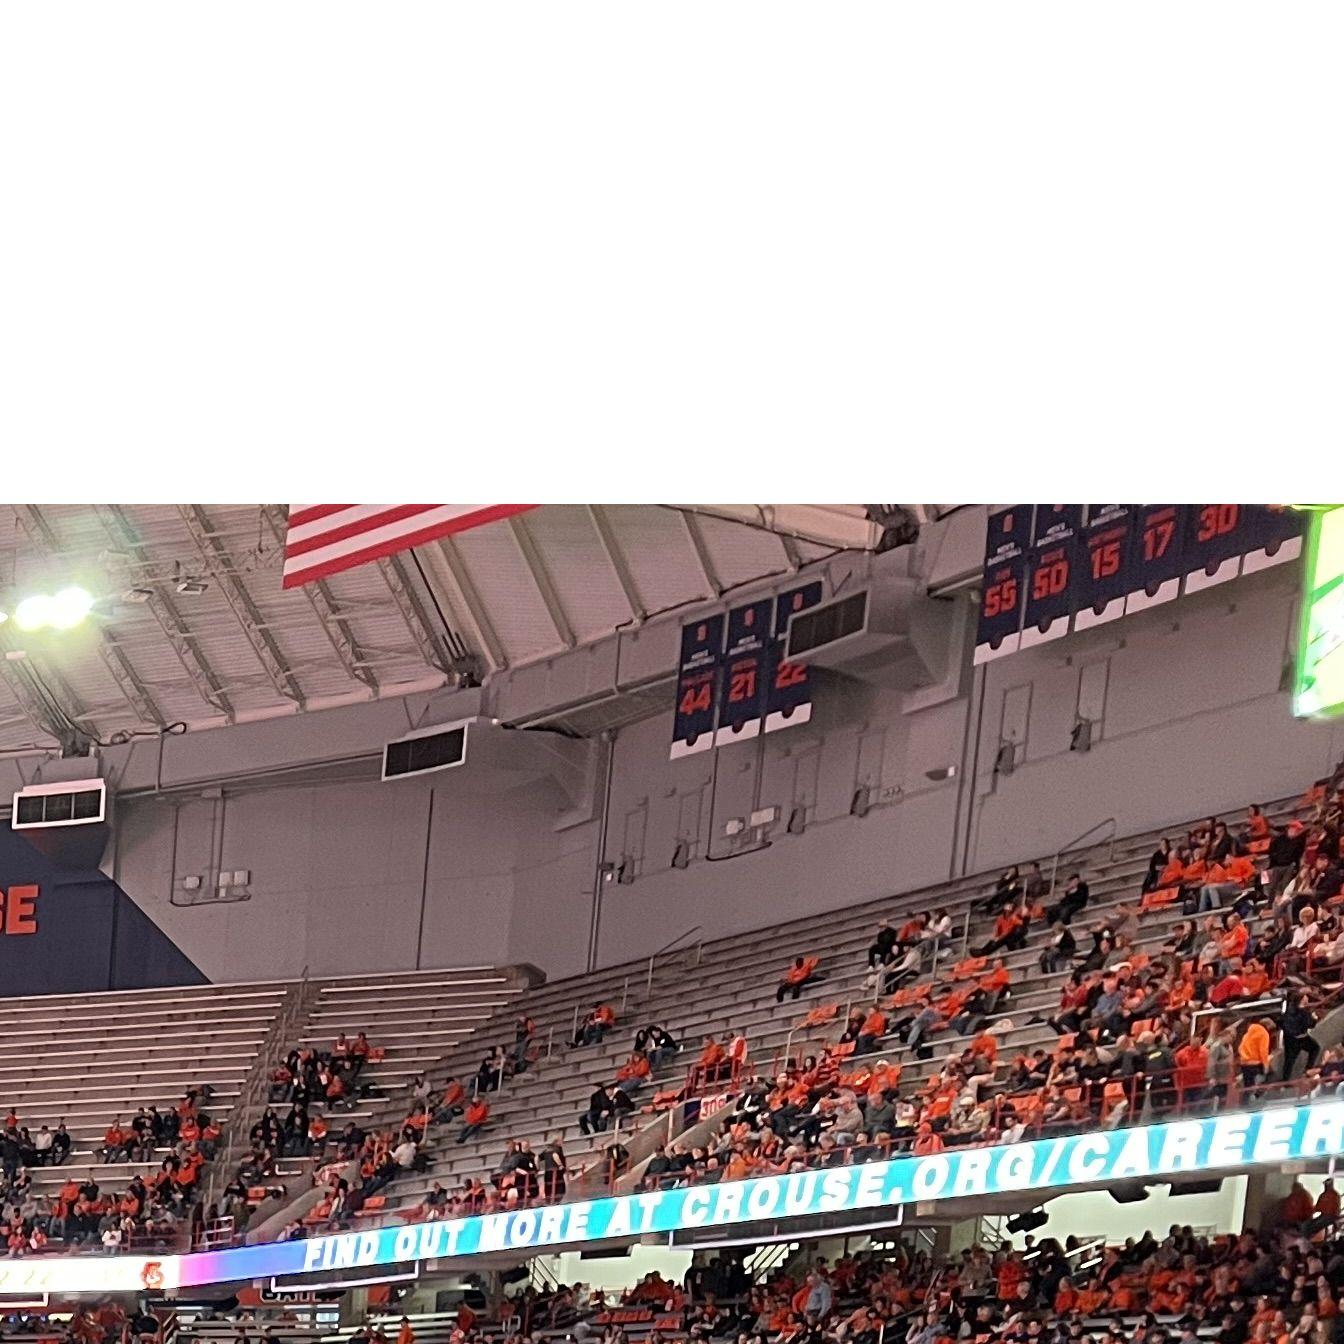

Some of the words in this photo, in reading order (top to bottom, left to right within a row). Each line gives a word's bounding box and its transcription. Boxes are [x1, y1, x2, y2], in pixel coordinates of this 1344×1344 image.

[1143, 520, 1175, 561] 17
[1198, 505, 1239, 541] 30
[1091, 541, 1121, 579] 15
[983, 578, 1016, 617] 55
[1033, 560, 1069, 600] 50
[679, 683, 711, 716] 44
[728, 671, 757, 703] 21
[304, 1235, 374, 1271] FIND
[395, 1225, 471, 1258] OUT
[478, 1211, 590, 1251] MORE
[606, 1196, 666, 1236] AT
